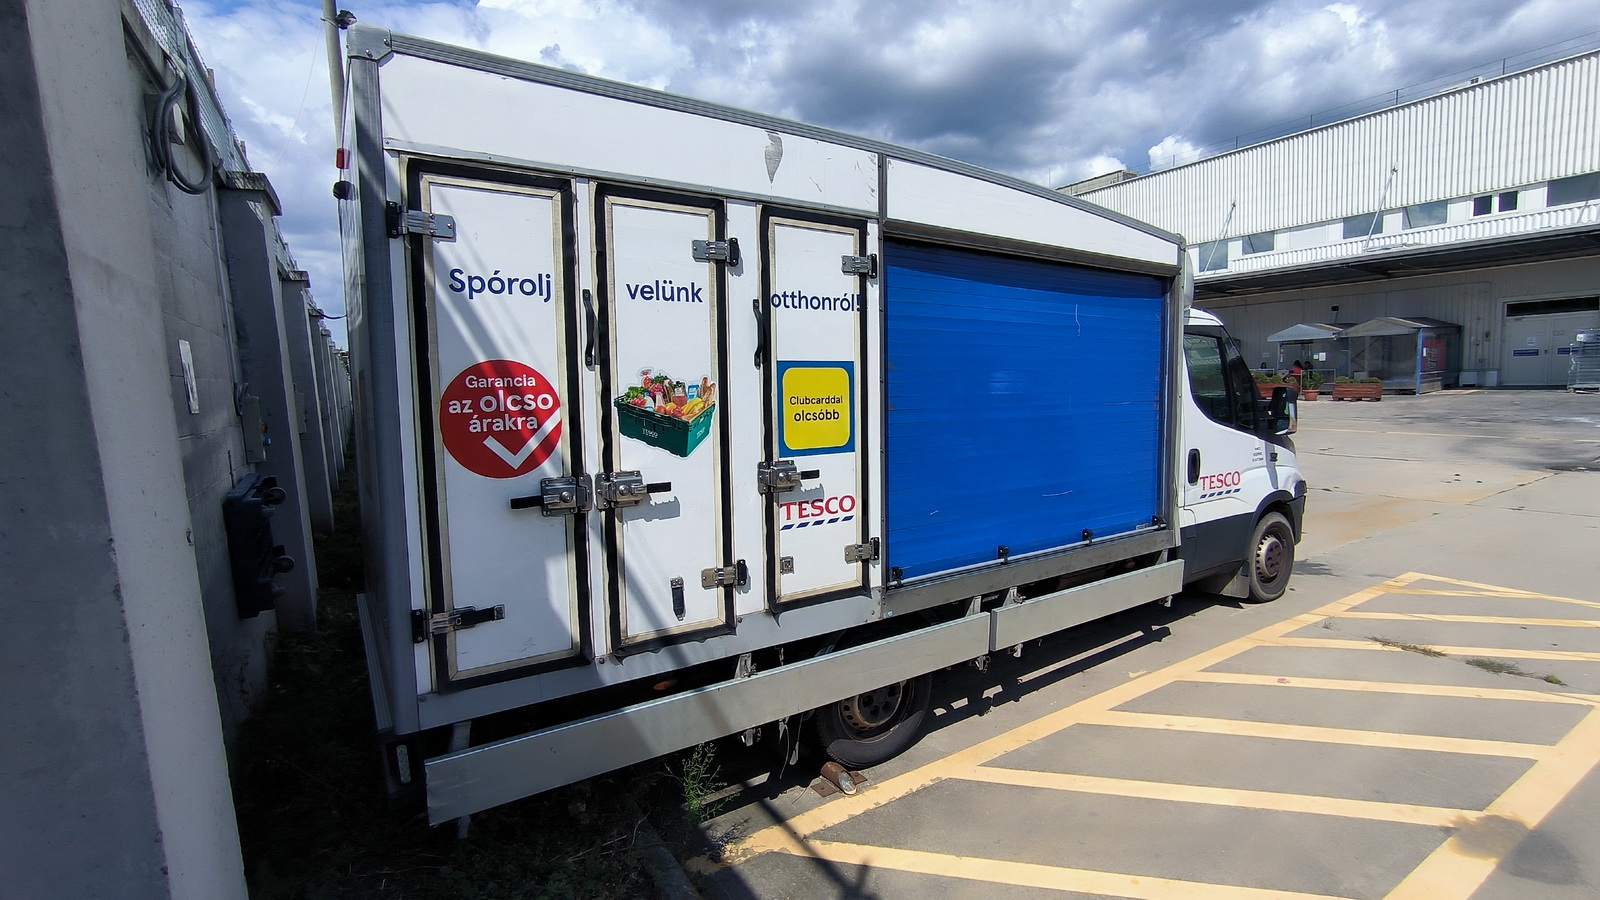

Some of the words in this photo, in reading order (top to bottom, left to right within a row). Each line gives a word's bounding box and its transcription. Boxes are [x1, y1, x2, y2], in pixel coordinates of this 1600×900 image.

[449, 268, 552, 303] Spórolj
[625, 279, 703, 303] velünk
[770, 290, 861, 312] otthonról!
[465, 374, 536, 389] Garancia
[448, 400, 474, 414] az
[479, 390, 554, 413] olcso
[789, 395, 843, 406] Clubcarddal
[469, 414, 538, 433] árakra
[794, 409, 840, 422] olcsóbb
[1200, 471, 1241, 491] TESCO
[780, 495, 856, 521] TESCO
